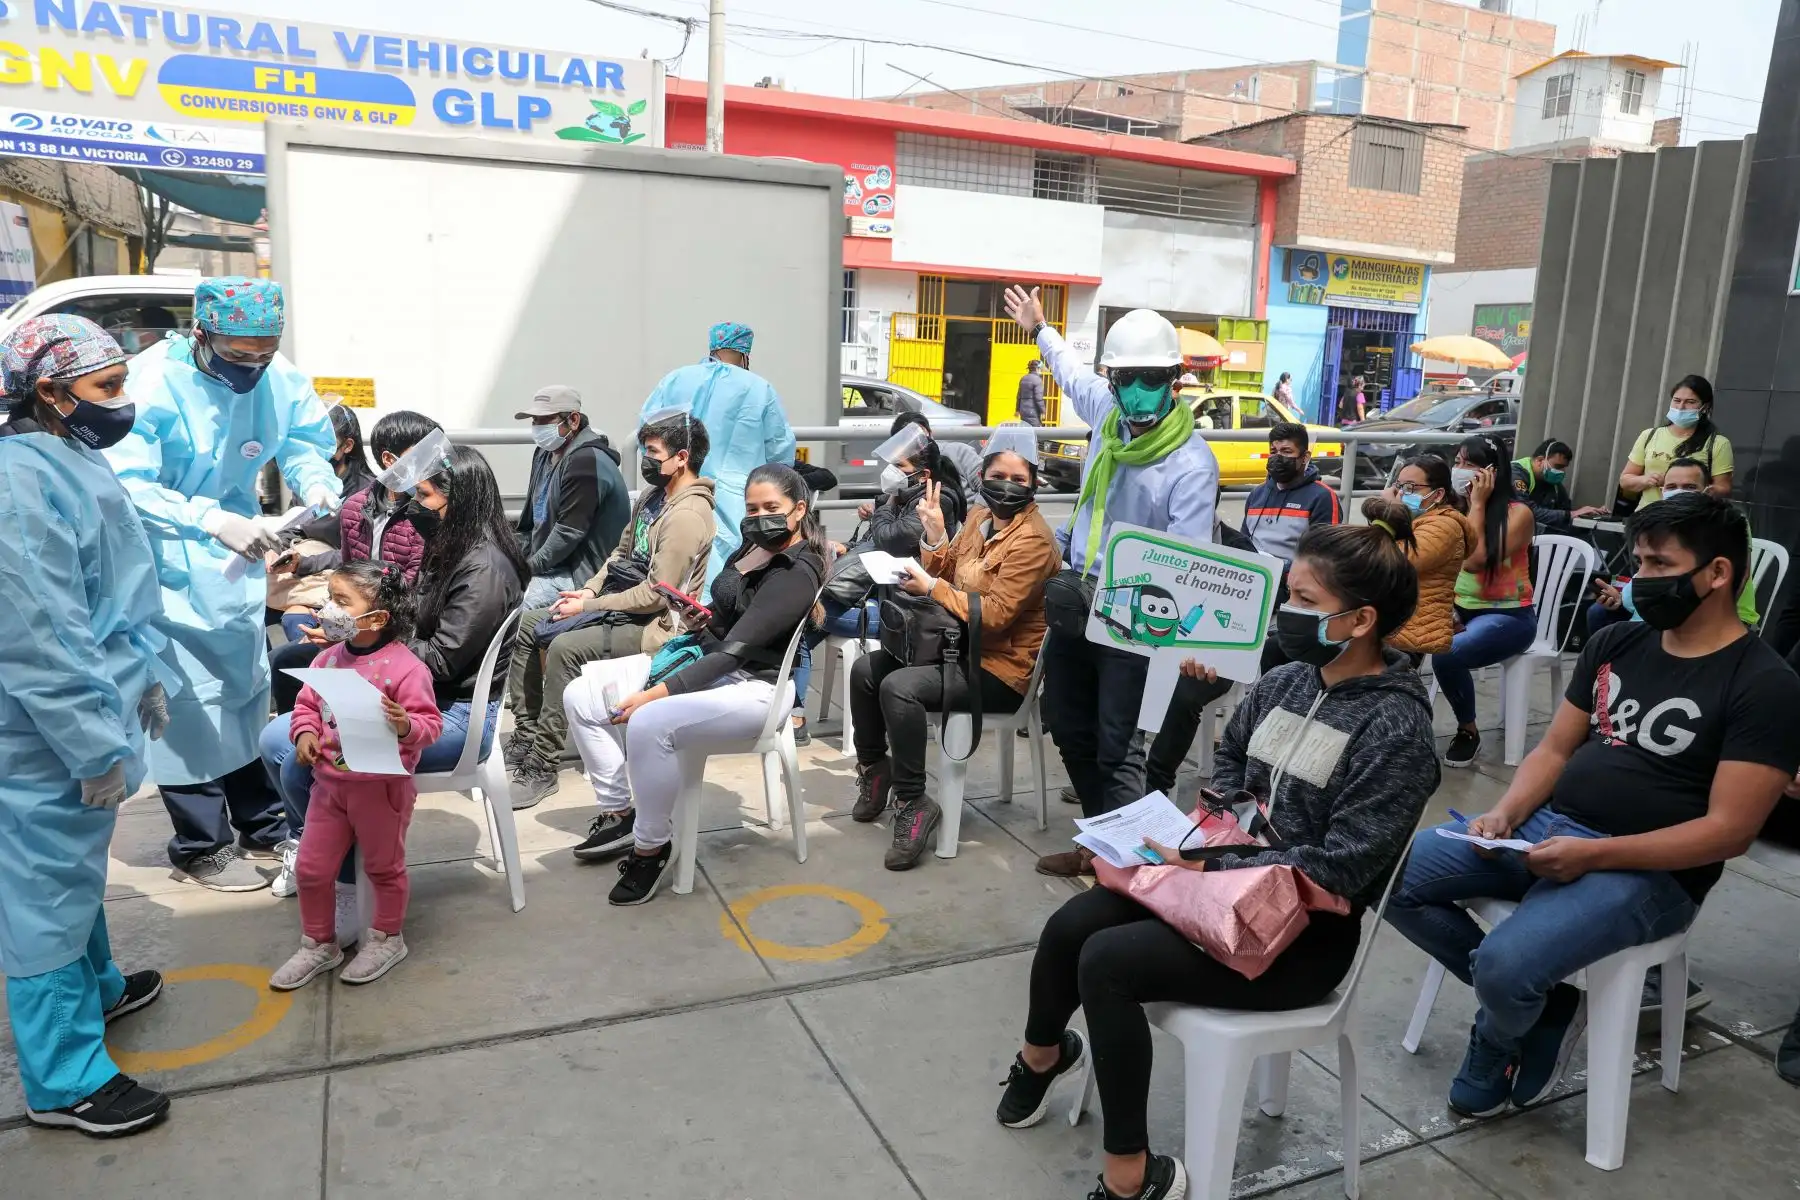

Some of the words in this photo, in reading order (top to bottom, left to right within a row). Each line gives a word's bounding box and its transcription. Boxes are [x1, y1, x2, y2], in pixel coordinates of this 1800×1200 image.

[34, 0, 316, 58] NATURAL
[333, 31, 625, 90] VEHICULAR
[0, 41, 148, 96] GNV
[254, 67, 317, 94] FH
[180, 93, 309, 118] CONVERSIONES
[314, 106, 347, 121] GNV
[353, 109, 364, 122] &
[368, 111, 398, 125] GLP
[432, 87, 552, 130] GLP
[50, 115, 133, 132] LOVATO
[51, 126, 134, 140] AUTOGAS
[19, 141, 36, 153] 13
[40, 143, 57, 156] 88
[60, 145, 79, 157] LA
[83, 147, 149, 163] VICTORIA
[192, 154, 233, 169] 32480
[237, 158, 254, 170] 29
[1333, 263, 1348, 274] MF
[1351, 259, 1420, 277] MANGUIFAJAS
[1351, 270, 1419, 286] INDUSTRIALES
[79, 425, 101, 442] DIRIS
[1141, 548, 1190, 569] ¡Juntos
[1188, 559, 1255, 585] ponemos
[1175, 572, 1189, 586] el
[1189, 575, 1253, 601] hombro!
